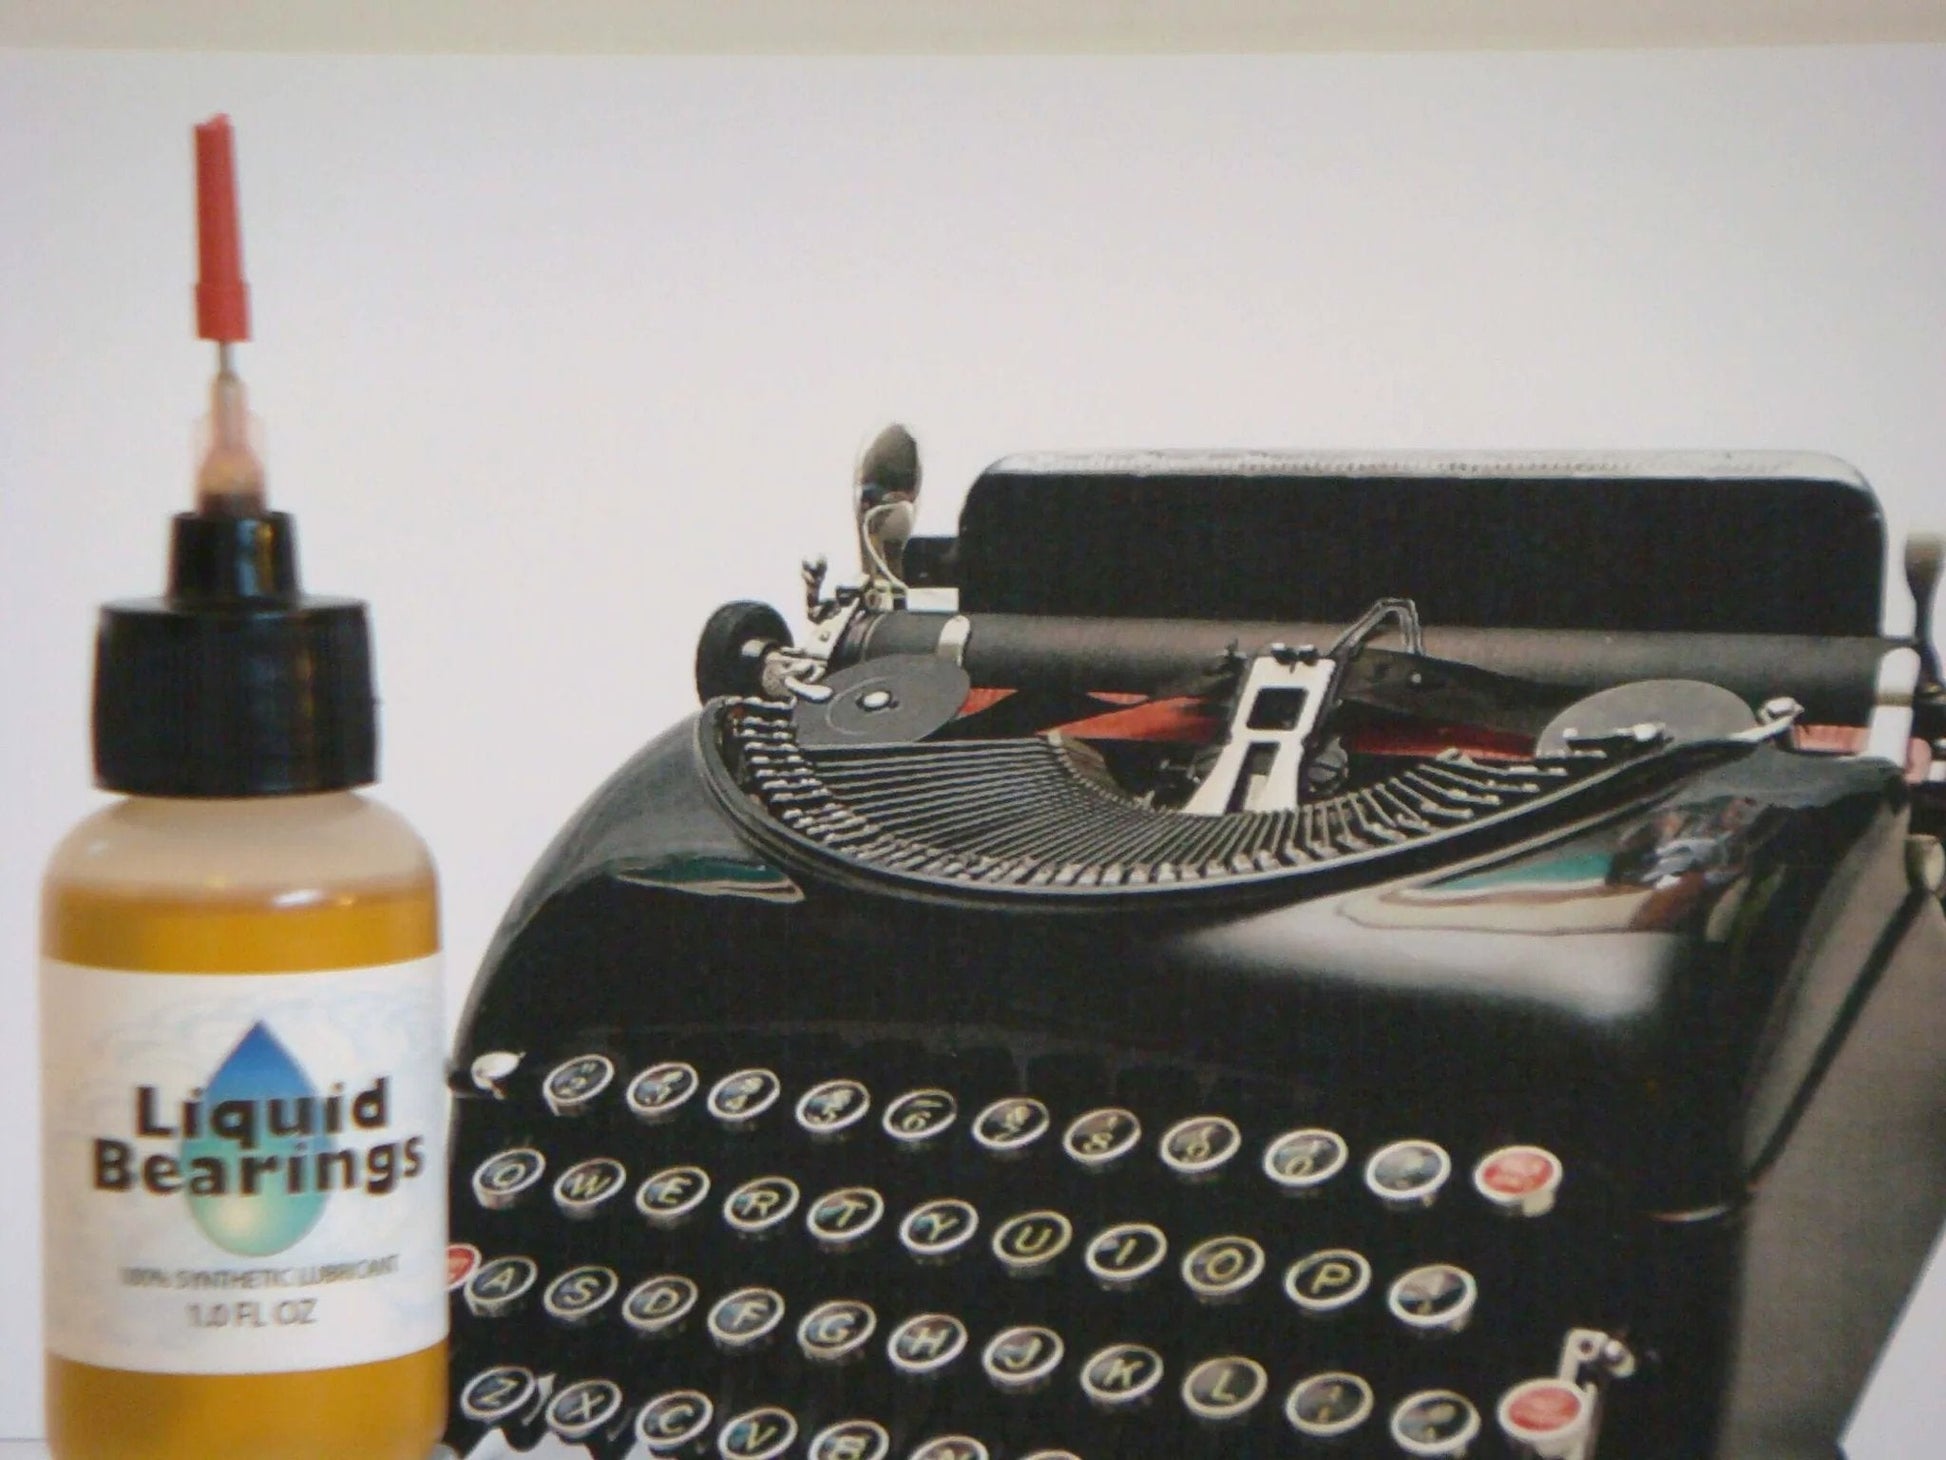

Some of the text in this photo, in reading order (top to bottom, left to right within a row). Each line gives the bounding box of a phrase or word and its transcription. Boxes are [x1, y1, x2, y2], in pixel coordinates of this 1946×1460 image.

[136, 1075, 391, 1149] Liquid
[92, 1135, 424, 1195] Bearings
[569, 1174, 611, 1199] W
[658, 1177, 692, 1203] E
[740, 1189, 779, 1217] R
[836, 1199, 868, 1228] T
[926, 1211, 960, 1242] Y
[1014, 1225, 1052, 1253] U
[1206, 1247, 1245, 1281] O
[1311, 1263, 1353, 1295] P
[174, 1267, 291, 1289] SYNTHETIC
[296, 1255, 398, 1286] LUBRICANT
[236, 1301, 266, 1328] FL
[274, 1298, 317, 1326] OZ
[483, 1266, 516, 1293] A
[563, 1276, 599, 1305] S
[645, 1287, 679, 1315] D
[732, 1300, 769, 1329] F
[909, 1327, 949, 1356] H
[1003, 1336, 1042, 1369] J
[1103, 1357, 1144, 1388] K
[1209, 1369, 1237, 1403] L
[477, 1377, 520, 1405] Z
[565, 1391, 605, 1422] X
[658, 1404, 694, 1434] C
[745, 1420, 778, 1450] V
